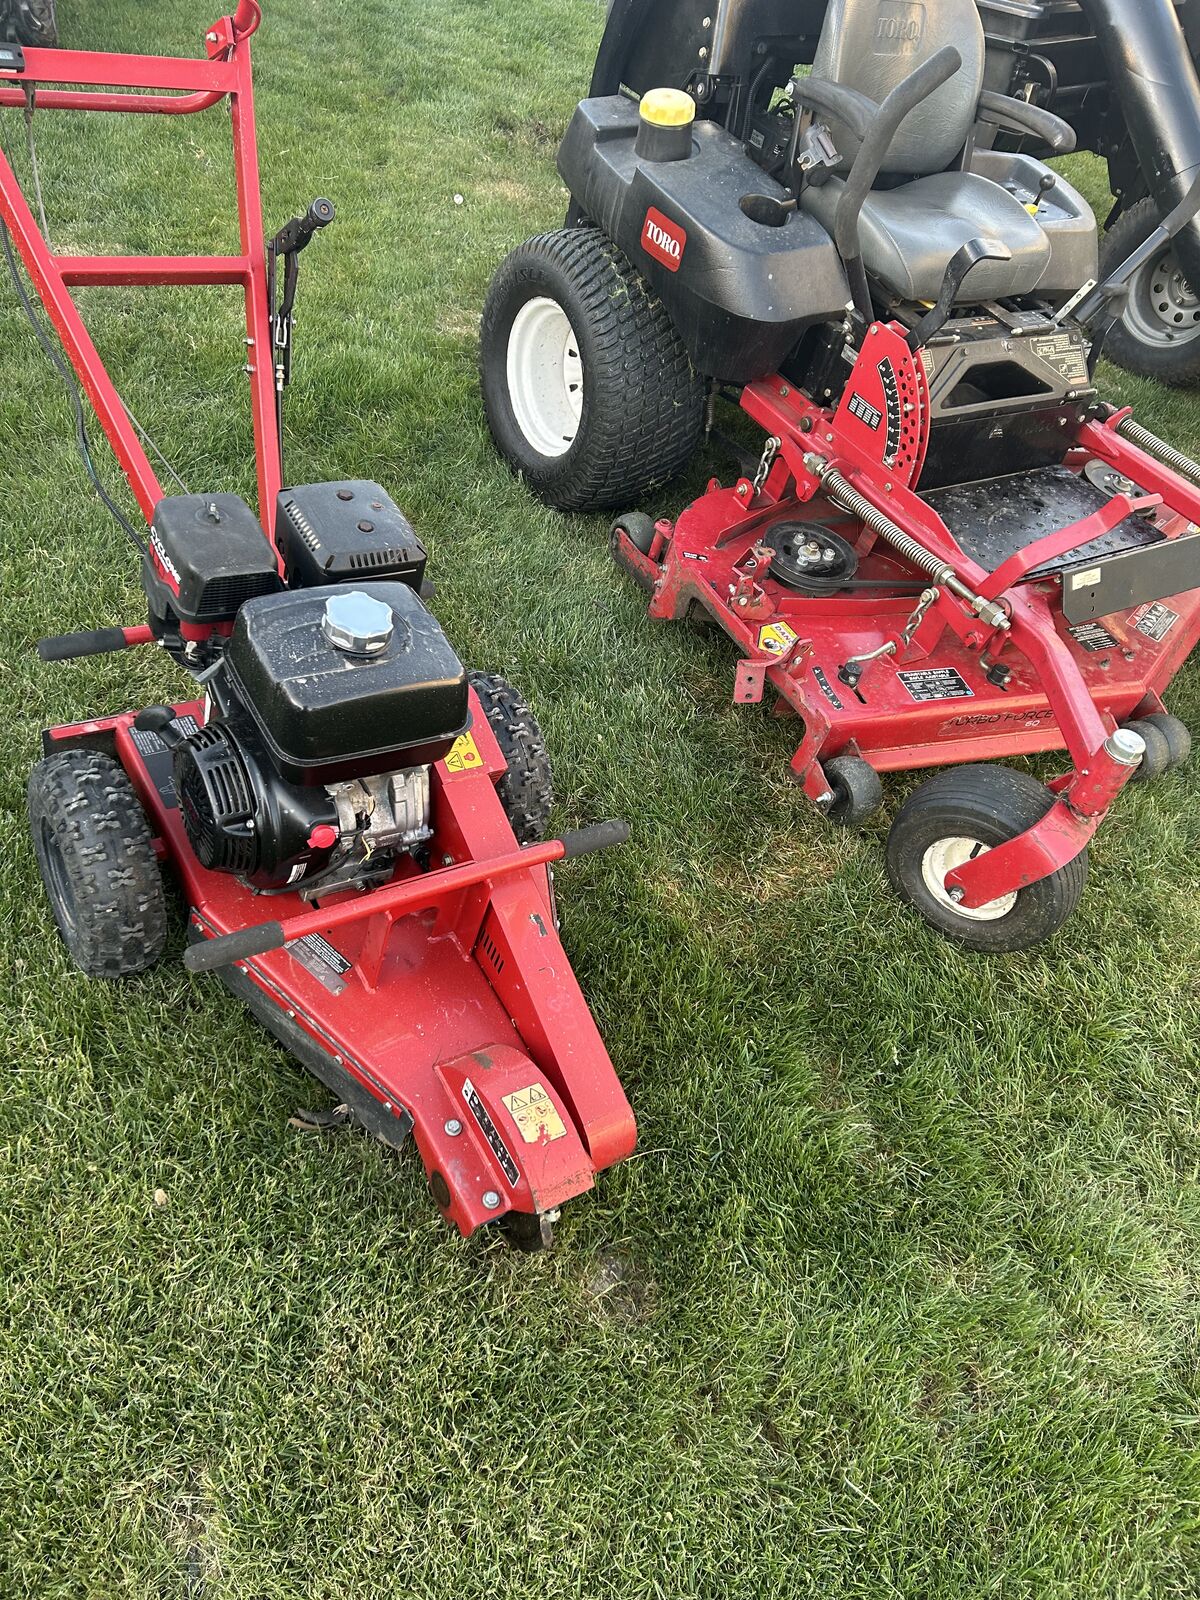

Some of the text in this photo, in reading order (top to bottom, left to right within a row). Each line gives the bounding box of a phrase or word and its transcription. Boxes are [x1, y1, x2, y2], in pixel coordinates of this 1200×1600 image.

[876, 17, 920, 41] TORO
[646, 219, 681, 259] TORO
[150, 525, 182, 585] CYCLONE
